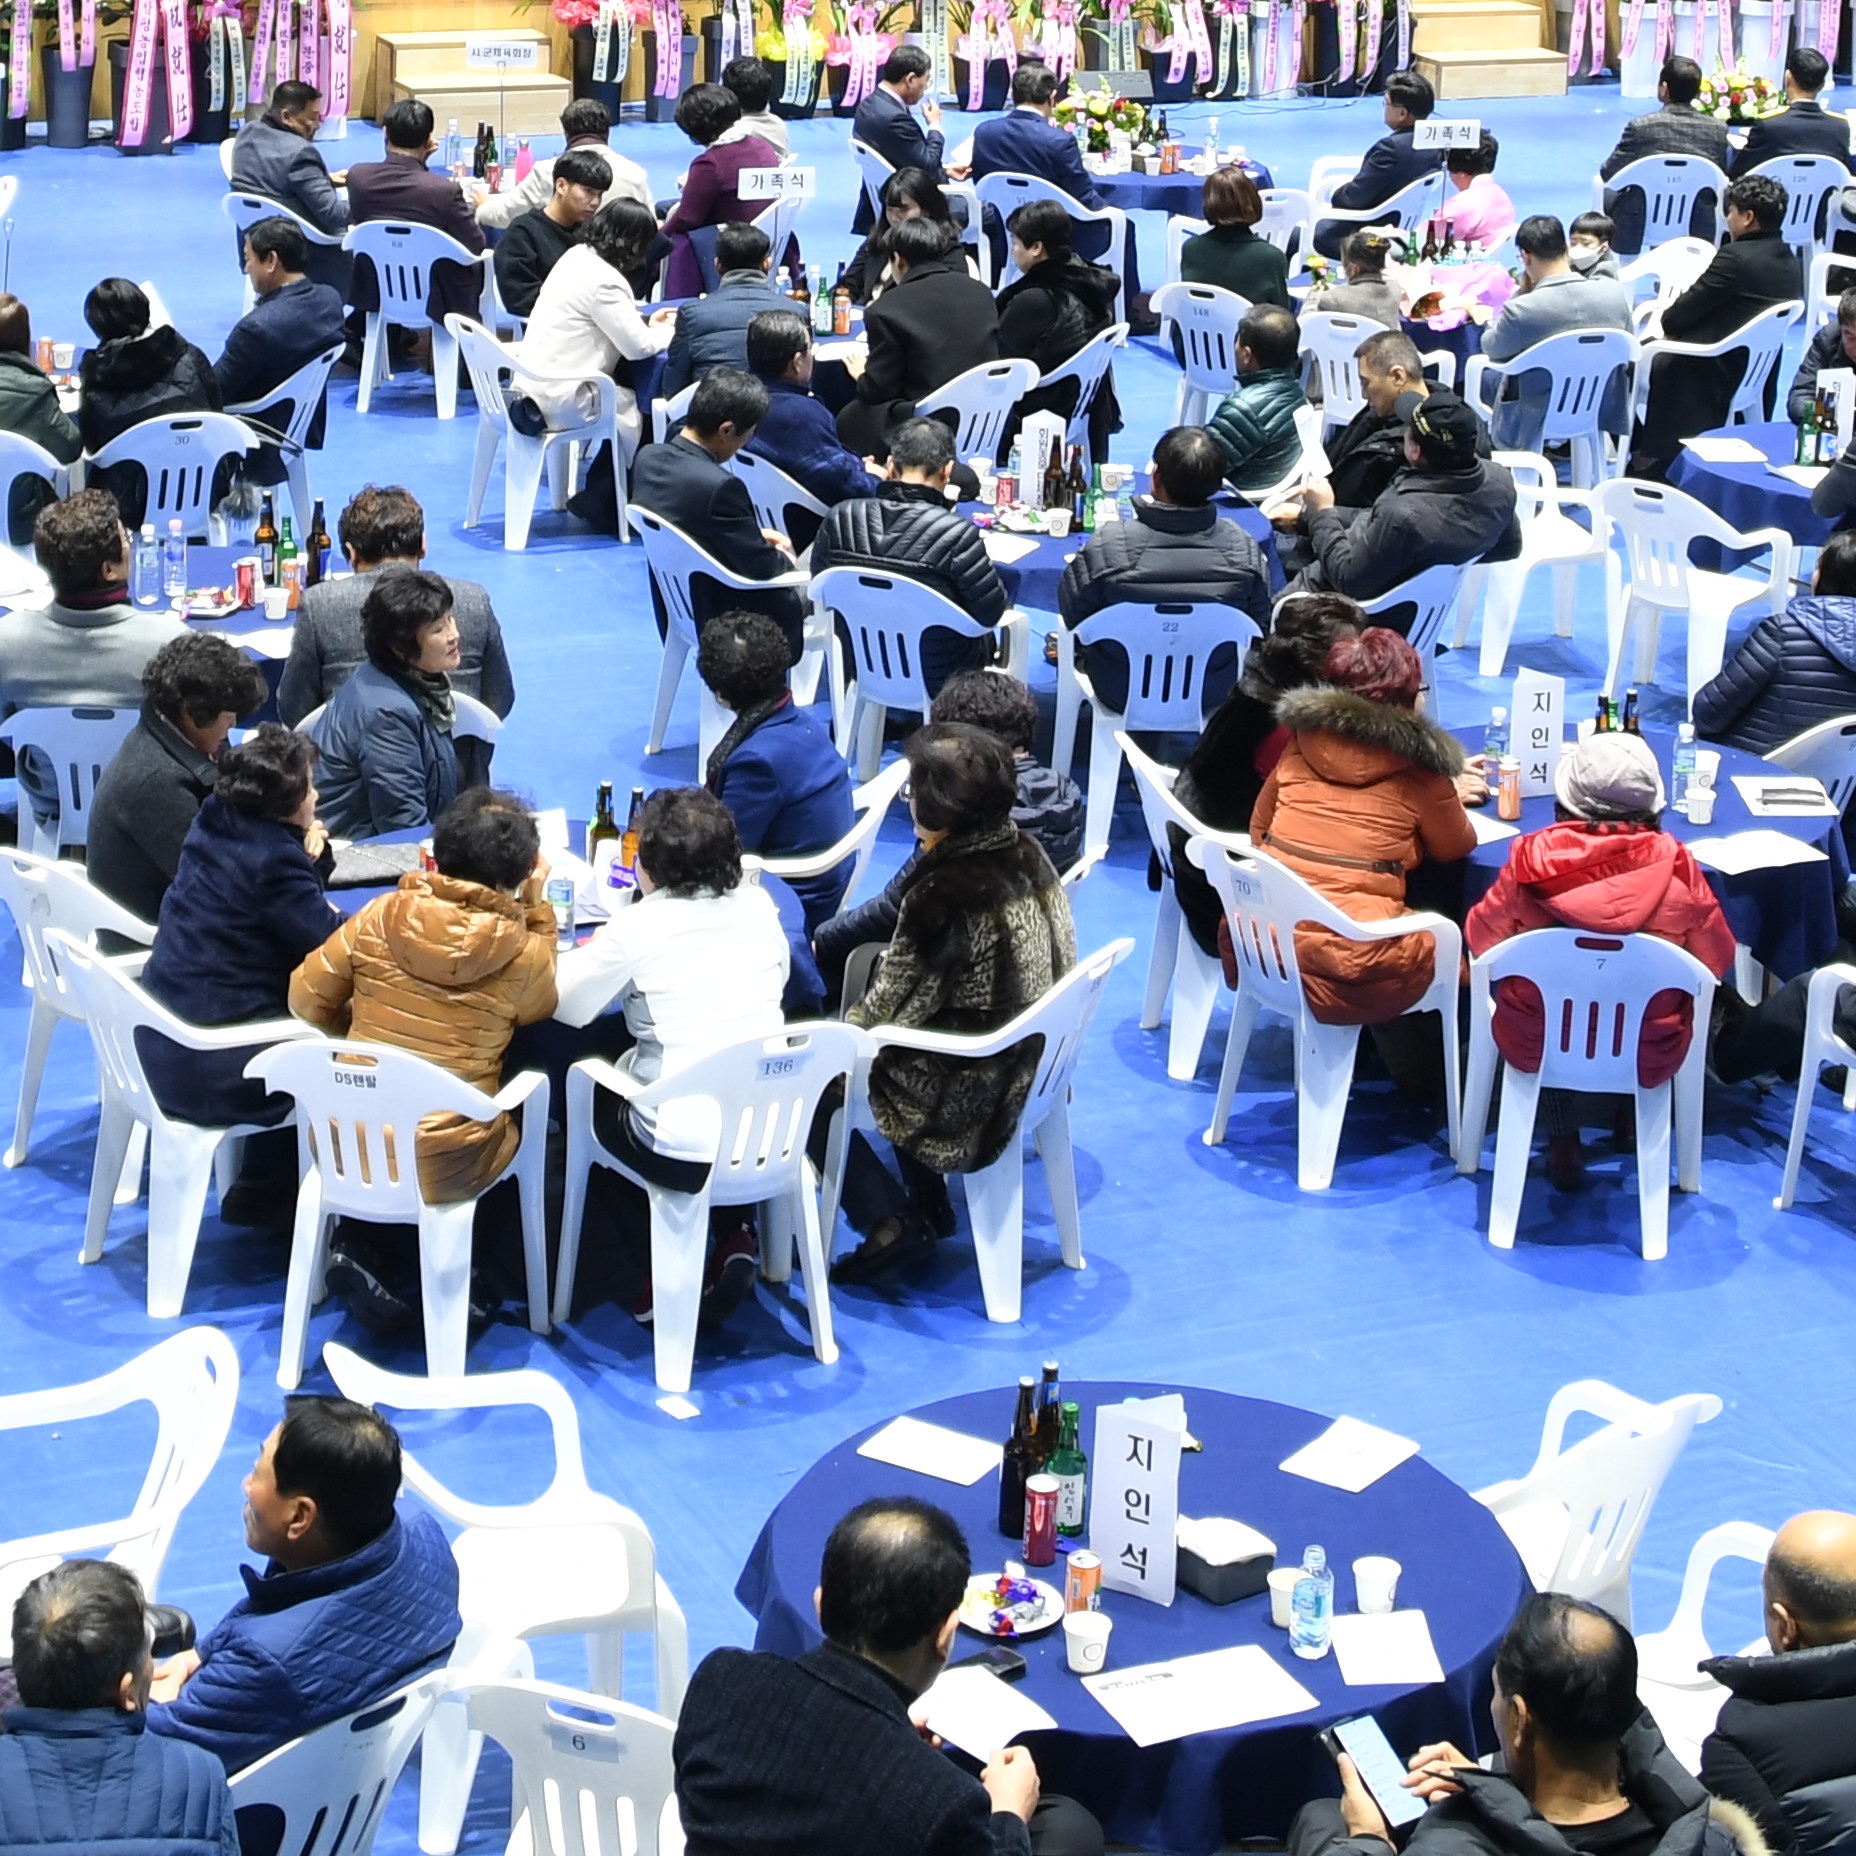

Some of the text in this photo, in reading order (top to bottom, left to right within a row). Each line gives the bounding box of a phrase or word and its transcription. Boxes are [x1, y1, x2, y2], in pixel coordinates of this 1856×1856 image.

[1424, 125, 1471, 140] 가족석
[750, 173, 804, 189] 가족석
[1193, 306, 1210, 318] 148
[174, 435, 190, 446] 30
[1162, 621, 1179, 632] 22
[1529, 691, 1551, 784] 지인석
[1235, 879, 1251, 895] 70
[1596, 958, 1607, 970] 7
[763, 1059, 794, 1076] 136
[334, 1071, 377, 1089] DS렌탈
[1119, 1433, 1154, 1581] 지인석
[572, 1734, 586, 1751] 6
